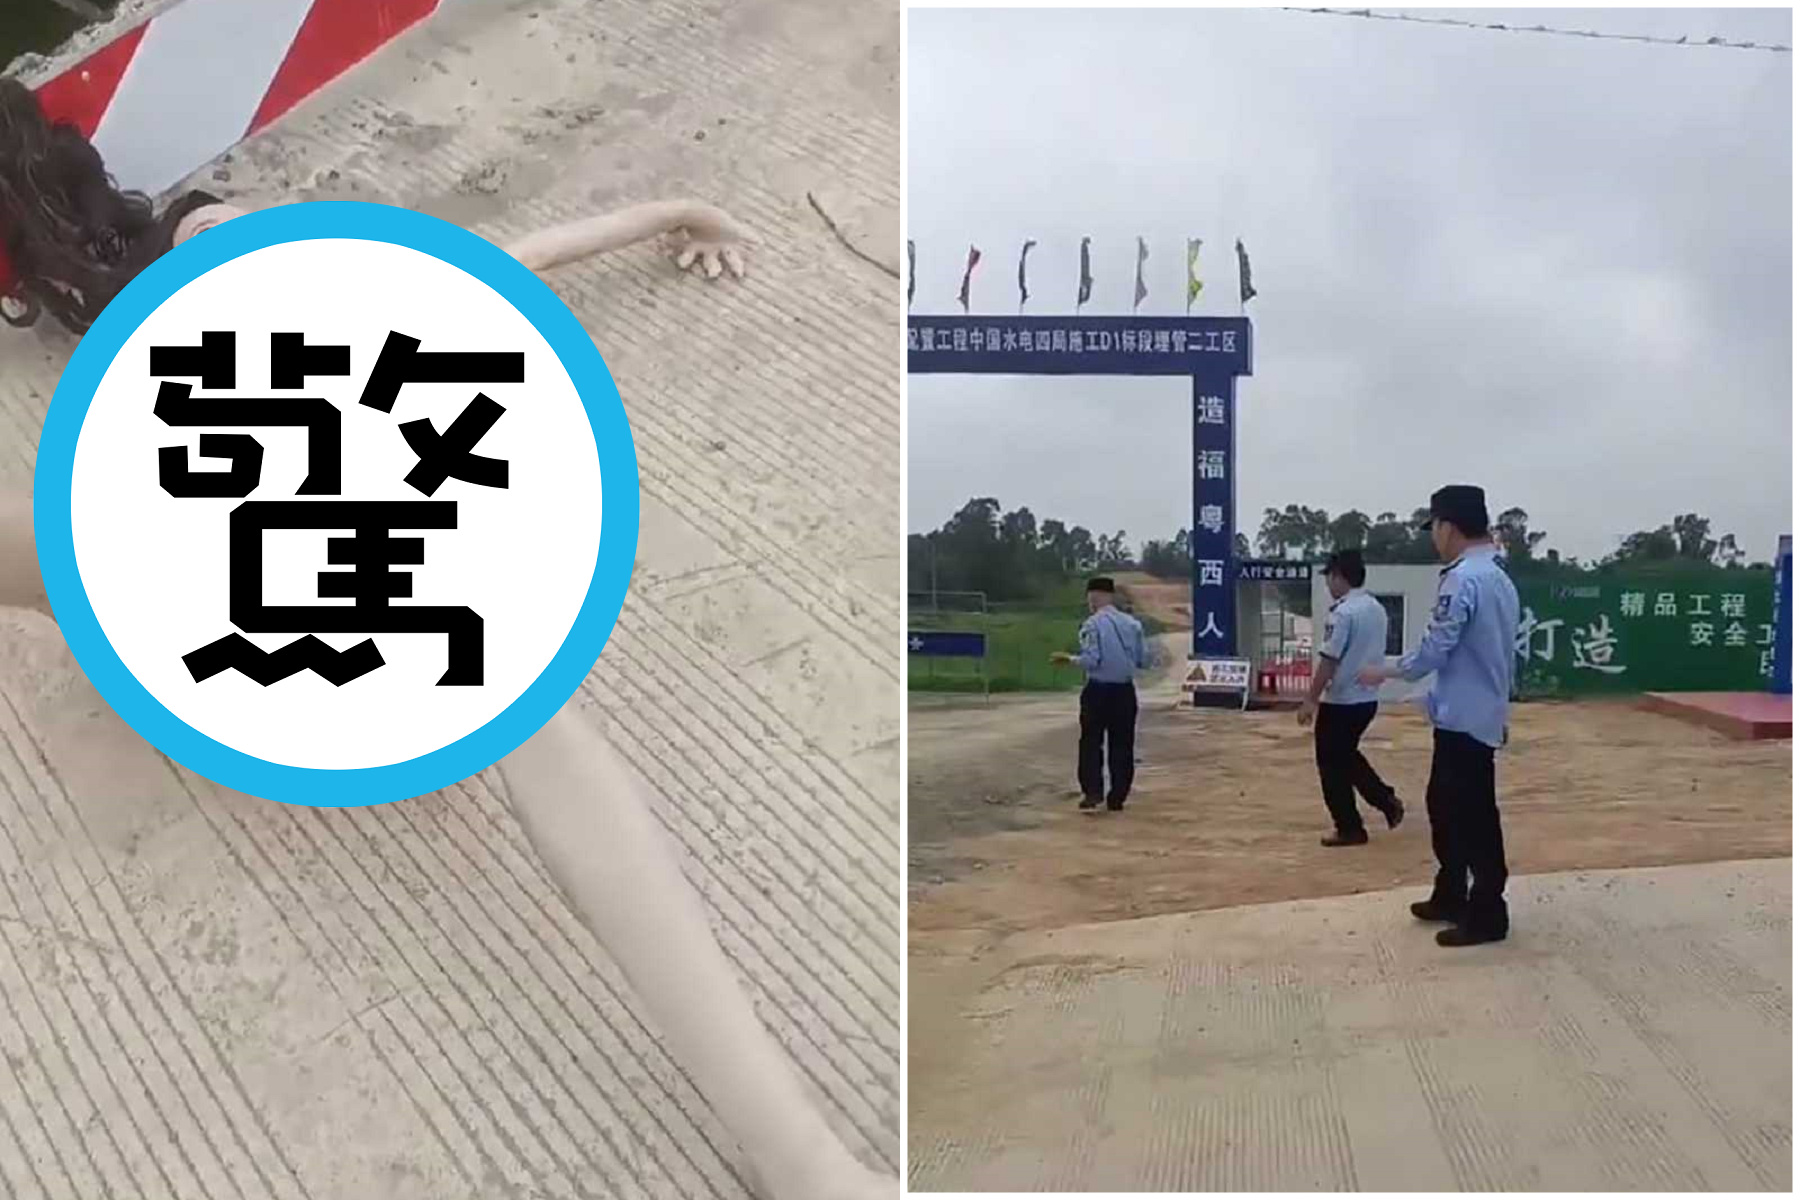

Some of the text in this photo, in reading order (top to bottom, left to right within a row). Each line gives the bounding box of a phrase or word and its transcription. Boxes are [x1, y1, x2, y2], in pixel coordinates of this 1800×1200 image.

[1197, 396, 1225, 638] 造福粤西人
[1619, 592, 1746, 617] 精品工程
[1515, 606, 1627, 674] 打造
